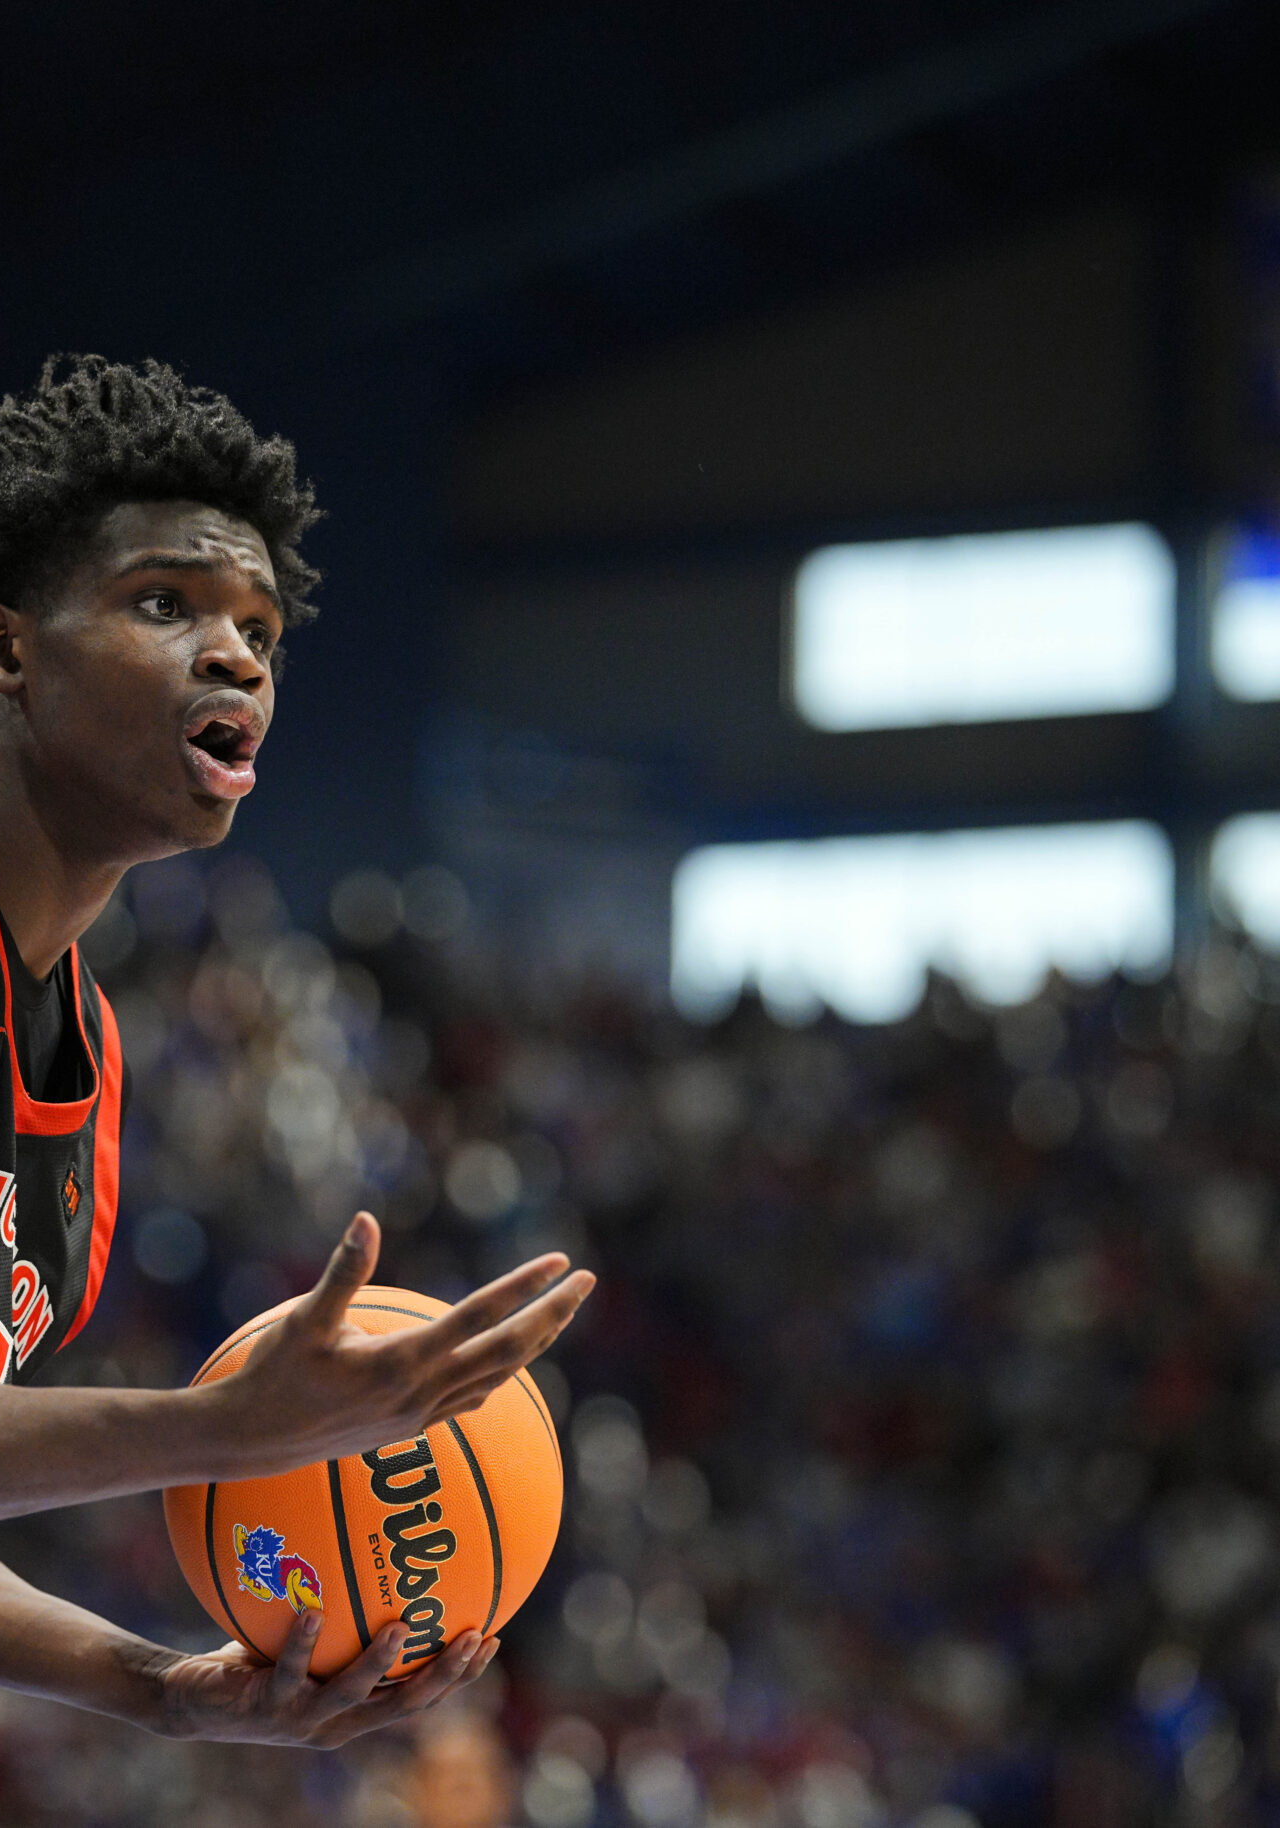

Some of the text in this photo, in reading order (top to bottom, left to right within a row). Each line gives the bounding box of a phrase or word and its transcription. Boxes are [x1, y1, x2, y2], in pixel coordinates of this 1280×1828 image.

[256, 1552, 273, 1577] KU
[368, 1533, 393, 1607] EVO NXT
